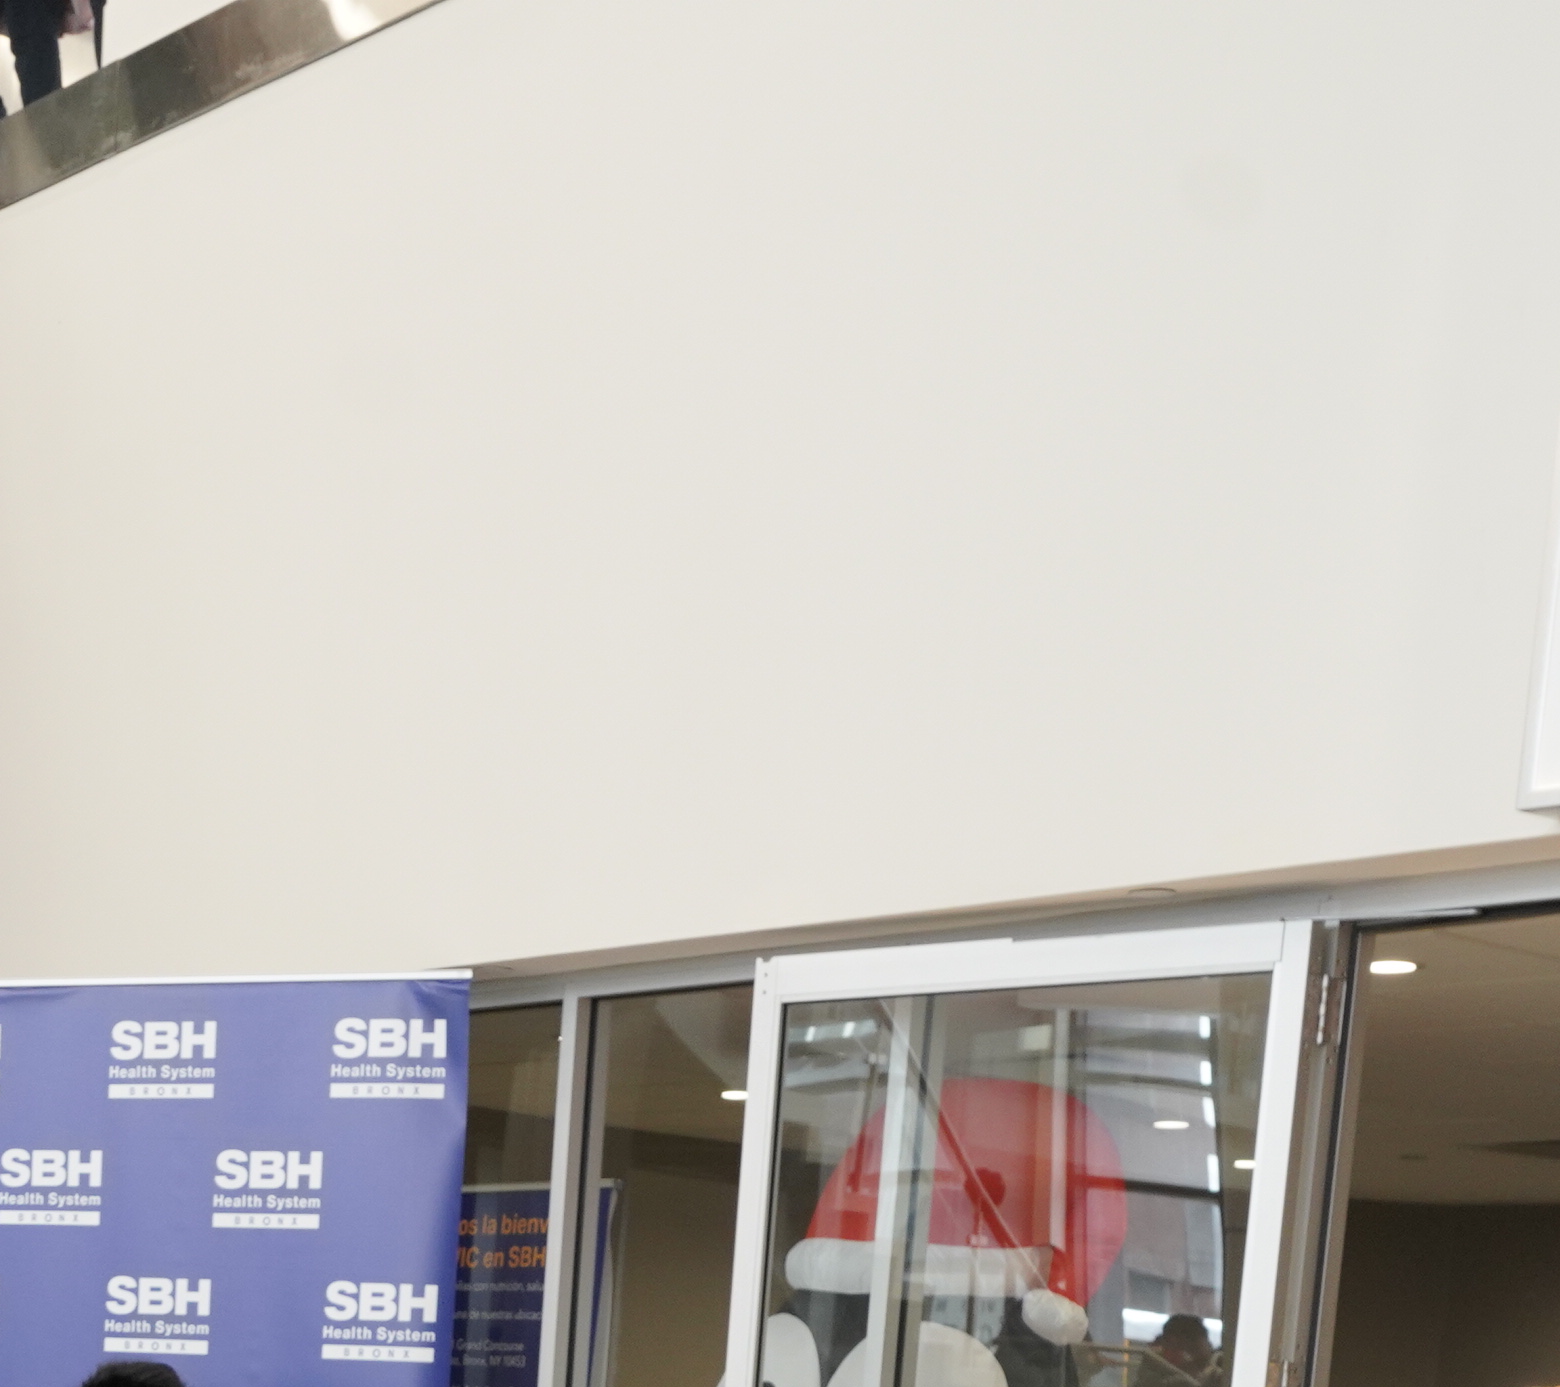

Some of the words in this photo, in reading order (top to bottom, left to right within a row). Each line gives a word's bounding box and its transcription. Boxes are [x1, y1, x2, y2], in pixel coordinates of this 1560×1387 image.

[110, 1020, 217, 1060] SBH
[333, 1017, 447, 1059] SBH
[109, 1065, 156, 1078] Health
[162, 1065, 215, 1081] System
[331, 1064, 382, 1077] Health
[387, 1064, 446, 1080] System
[0, 1148, 103, 1188] SBH
[215, 1149, 323, 1190] SBH
[48, 1192, 101, 1209] System
[213, 1194, 261, 1207] Health
[266, 1195, 320, 1210] System
[483, 1212, 497, 1235] la
[500, 1212, 548, 1235] bienv
[457, 1248, 478, 1268] IC
[483, 1251, 504, 1267] en
[508, 1246, 546, 1268] SBH
[106, 1275, 211, 1317] SBH
[324, 1280, 438, 1323] SBH
[104, 1319, 151, 1332] Health
[155, 1321, 209, 1336] System
[322, 1325, 372, 1340] Health
[378, 1327, 435, 1343] System
